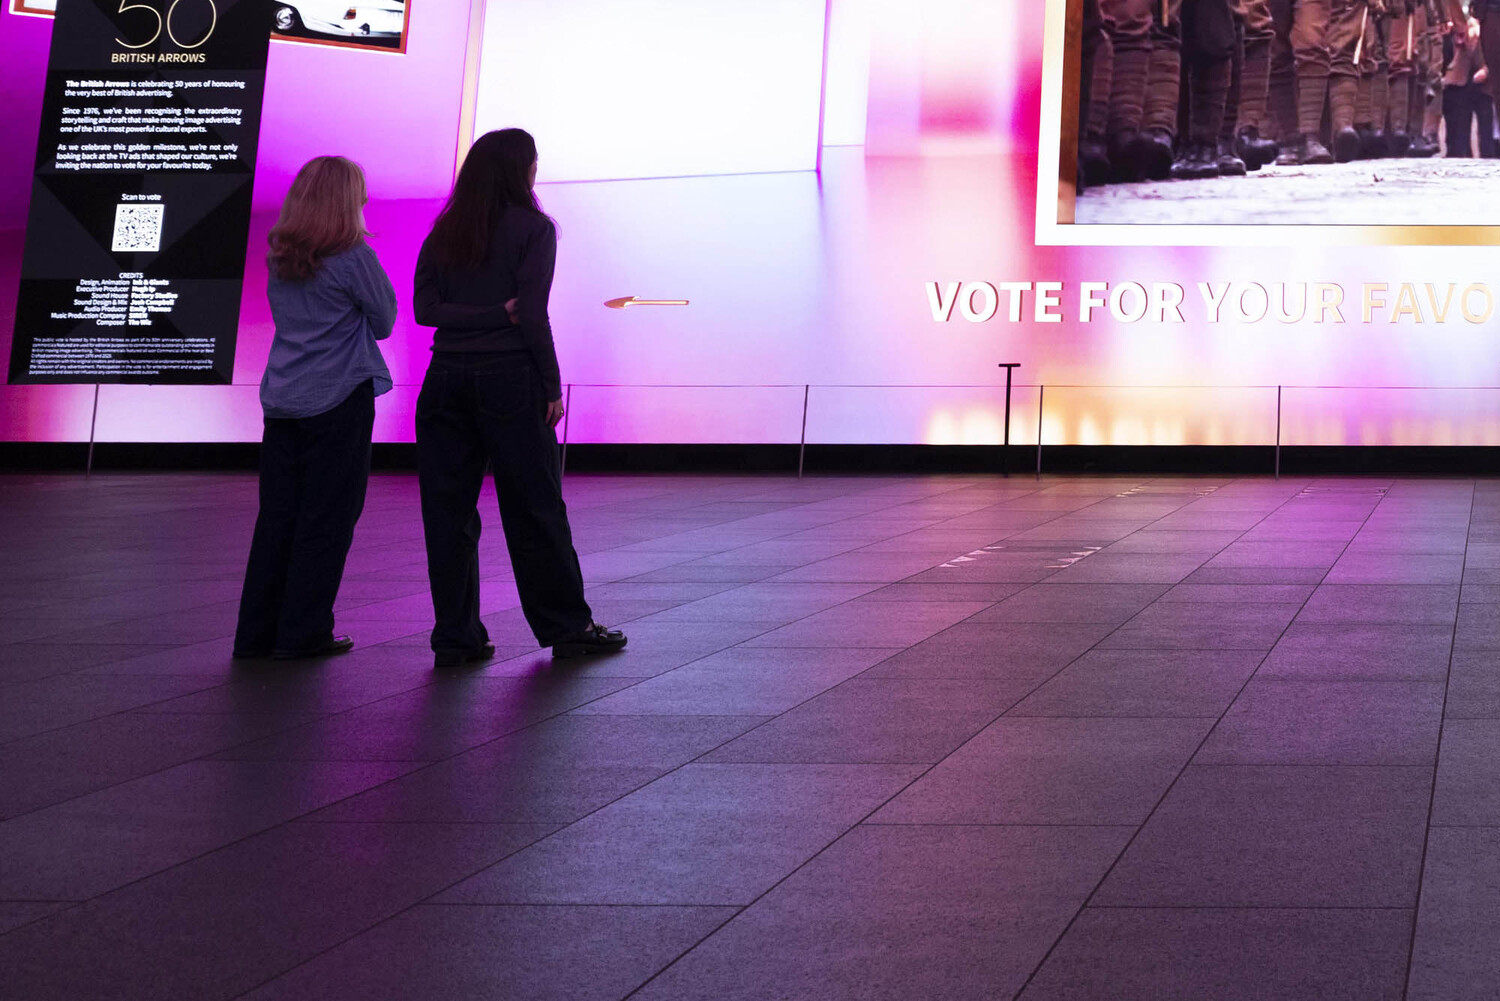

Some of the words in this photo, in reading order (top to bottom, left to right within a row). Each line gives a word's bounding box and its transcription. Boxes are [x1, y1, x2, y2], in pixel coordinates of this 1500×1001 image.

[111, 53, 155, 63] BRITISH
[158, 53, 206, 63] ARROWS
[138, 81, 174, 89] celebrating
[211, 81, 246, 89] honouring
[136, 90, 174, 98] advertising.
[144, 108, 182, 116] recognising
[198, 108, 243, 116] extraordinary
[61, 117, 98, 125] storytelling
[160, 117, 185, 125] moving
[184, 117, 205, 125] image
[205, 117, 242, 125] advertising
[125, 126, 155, 134] powerful
[180, 126, 208, 134] exports.
[128, 144, 151, 152] golden
[223, 144, 238, 152] only
[56, 153, 81, 161] looking
[156, 153, 180, 161] shaped
[55, 162, 80, 170] inviting
[192, 162, 213, 170] today.
[925, 281, 1064, 323] VOTE
[1078, 281, 1185, 323] FOR
[1197, 282, 1346, 324] YOUR
